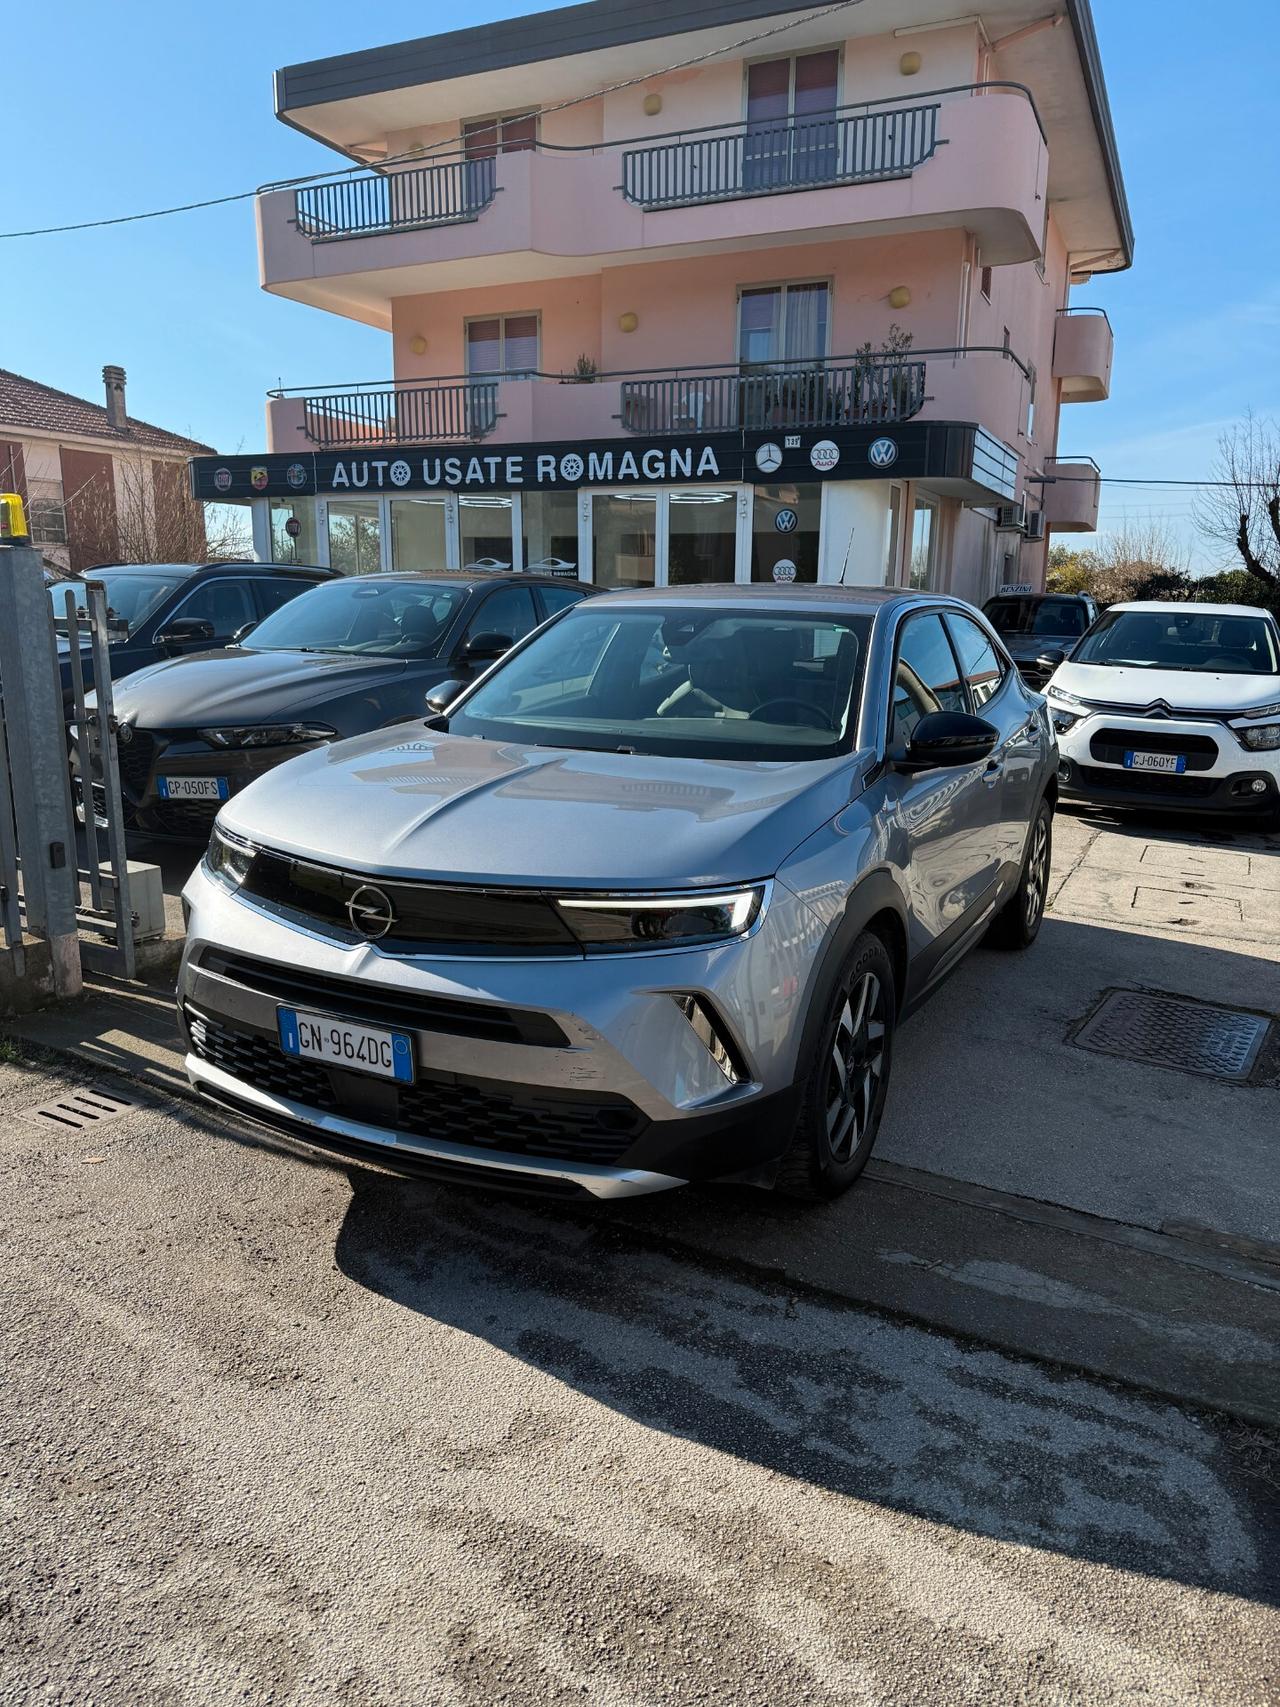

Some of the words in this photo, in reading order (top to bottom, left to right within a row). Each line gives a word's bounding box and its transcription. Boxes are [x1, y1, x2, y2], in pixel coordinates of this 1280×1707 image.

[332, 460, 411, 487] AUTO
[422, 456, 524, 486] USATE
[537, 446, 720, 482] ROMAGNA
[814, 459, 837, 467] Audi
[1001, 585, 1032, 593] BENZINA
